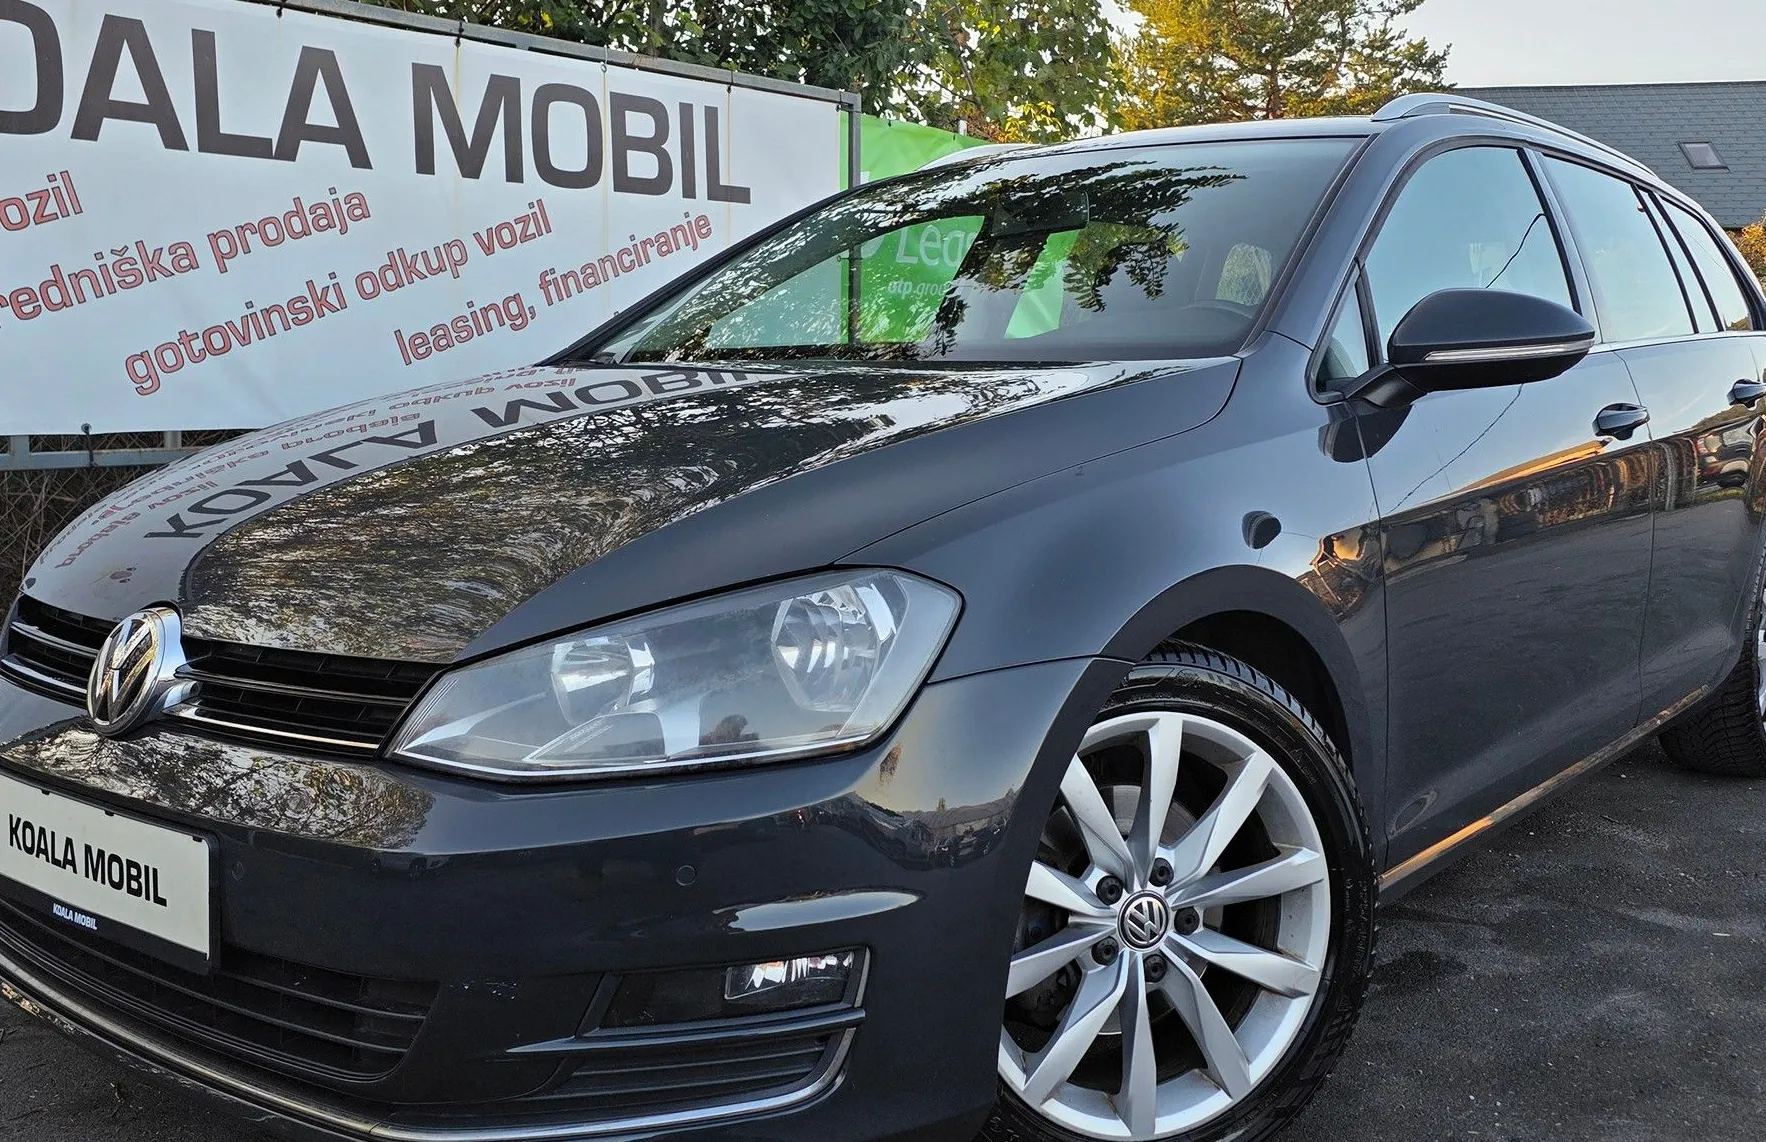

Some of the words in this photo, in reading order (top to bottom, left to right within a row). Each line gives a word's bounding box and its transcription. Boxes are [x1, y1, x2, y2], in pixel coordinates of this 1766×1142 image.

[411, 62, 751, 204] MOBIL
[206, 187, 371, 274] prodaja
[394, 292, 536, 366] leasing,
[538, 211, 712, 307] financiranje
[125, 272, 348, 396] gotovinski
[355, 239, 469, 301] odkup
[473, 199, 552, 256] vozil
[8, 813, 78, 875] KOALA
[84, 843, 168, 907] MOBIL
[52, 903, 74, 921] KOALA
[73, 911, 98, 931] MOBIL
